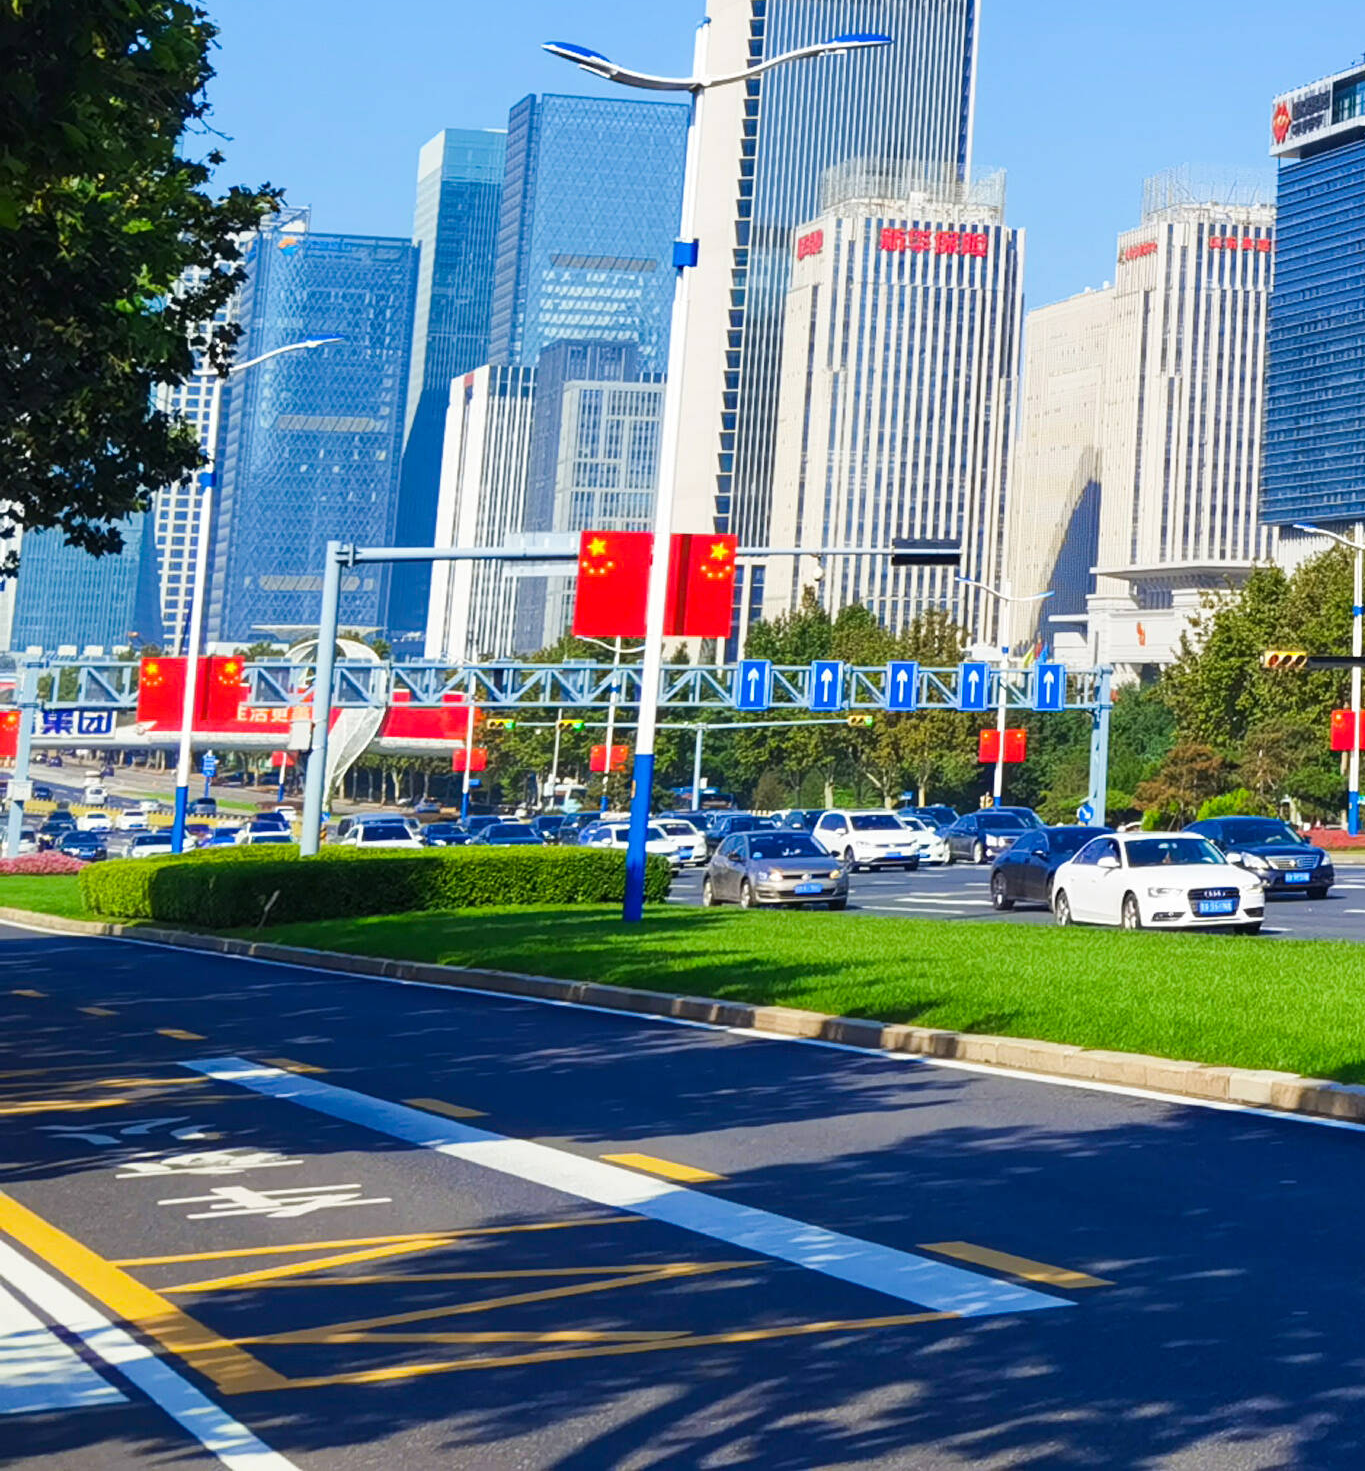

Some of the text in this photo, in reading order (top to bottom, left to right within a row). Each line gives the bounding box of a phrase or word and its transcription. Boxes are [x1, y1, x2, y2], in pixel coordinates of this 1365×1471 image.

[880, 227, 990, 258] 新华保险
[31, 710, 112, 735] 集团
